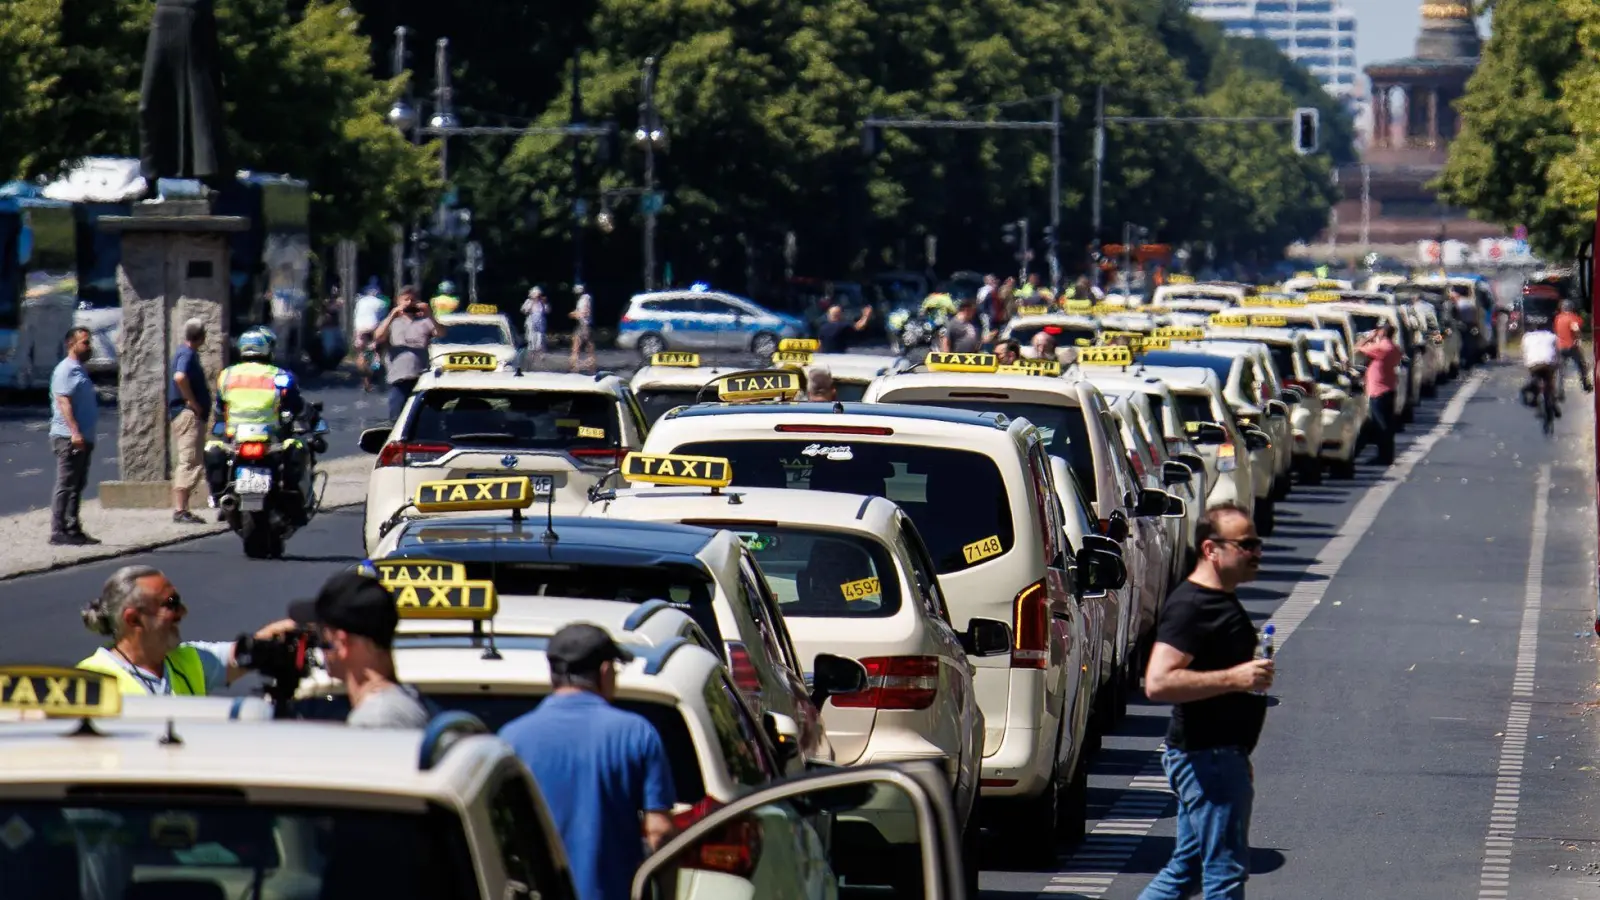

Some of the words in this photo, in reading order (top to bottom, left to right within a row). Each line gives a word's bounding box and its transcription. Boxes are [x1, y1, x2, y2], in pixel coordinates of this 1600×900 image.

[453, 356, 487, 365] TAXI
[663, 354, 690, 362] TAXI
[939, 354, 985, 365] TAXI
[735, 376, 783, 391] TAXI
[641, 457, 712, 478] TAXI
[432, 482, 508, 502] TAXI
[965, 538, 1000, 561] 7148
[380, 566, 444, 581] TAXI
[387, 584, 471, 608] AXI
[844, 579, 880, 599] 4597
